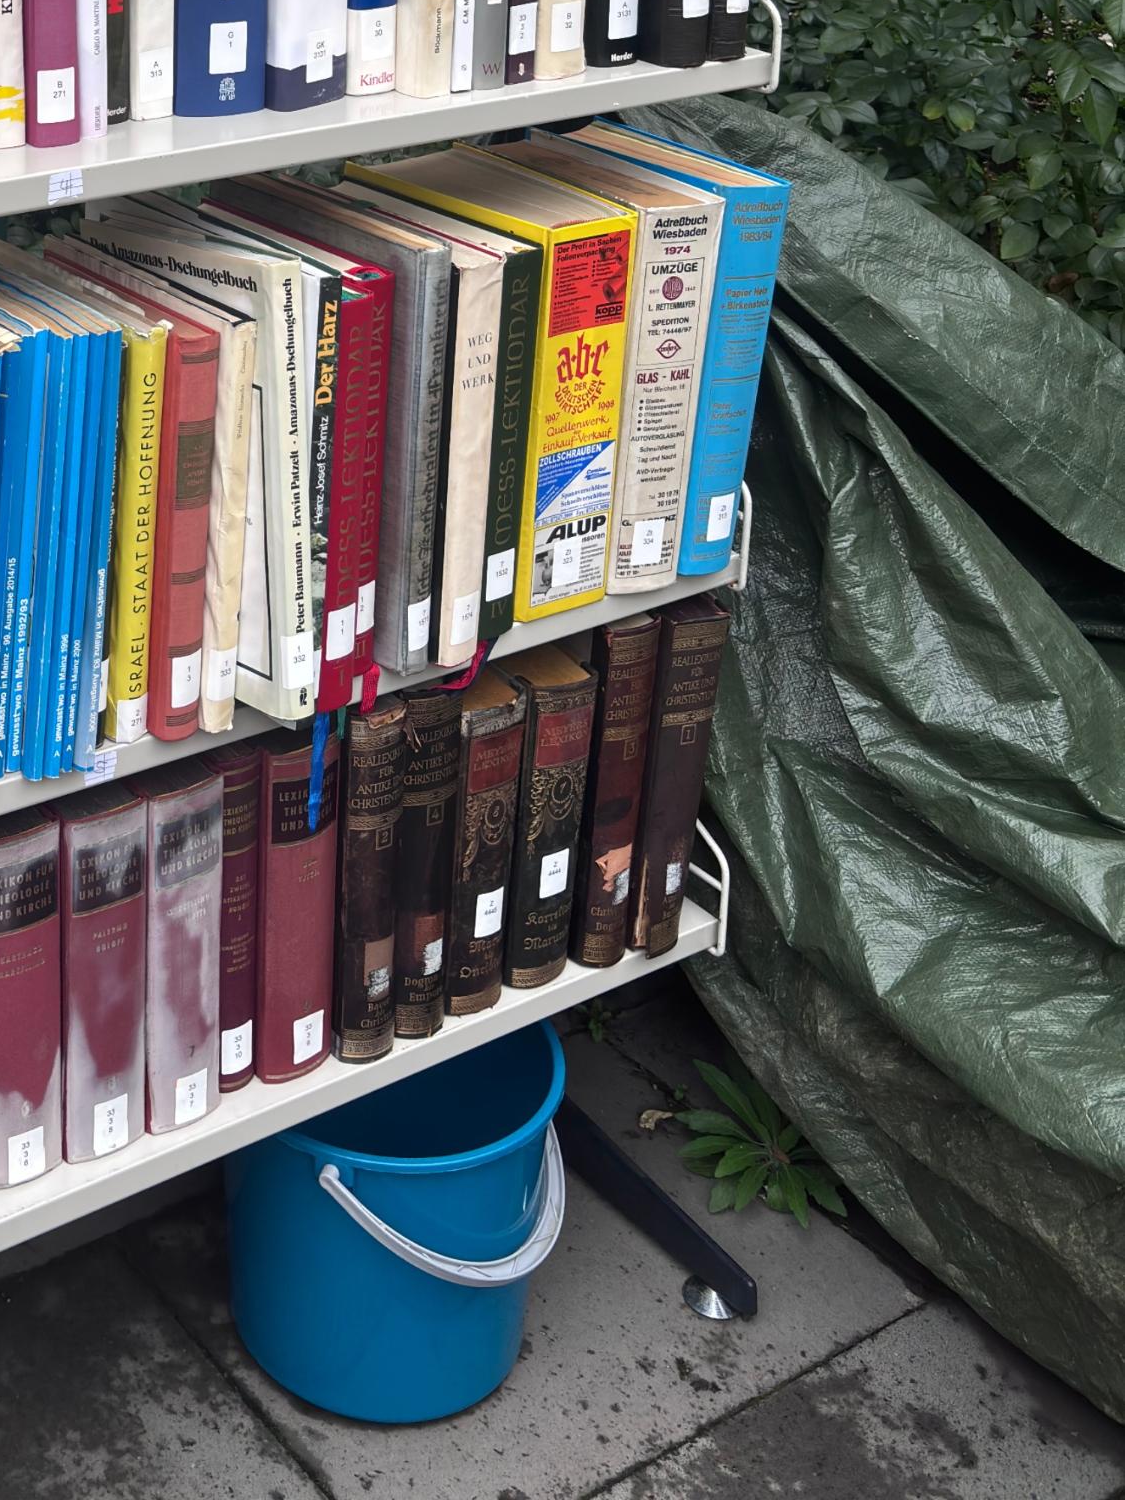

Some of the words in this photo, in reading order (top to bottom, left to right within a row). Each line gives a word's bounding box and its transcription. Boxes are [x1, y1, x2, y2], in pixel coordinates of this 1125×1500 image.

[360, 72, 395, 86] Kindler
[652, 228, 707, 239] Wiesbaden
[655, 214, 708, 228] Adreßbuch
[665, 246, 690, 255] 1974
[652, 262, 698, 275] UMZÜGE
[596, 305, 622, 316] kopp
[652, 317, 689, 326] SPEDITION
[317, 300, 338, 357] Harz
[282, 277, 299, 436] Amazonas-Dschungelbuch
[315, 364, 335, 404] Der
[637, 372, 658, 384] GLAS
[671, 369, 690, 381] KAHL
[137, 372, 157, 496] HOFFNUNG
[317, 416, 330, 460] Schmitz
[543, 428, 612, 453] Einkauf-Verkauf
[547, 416, 609, 437] Quellenwerk
[290, 450, 301, 492] Patzelt
[540, 443, 602, 467] ZOLLSCHRAUBEN
[313, 463, 326, 524] Heinz-Josef
[136, 503, 151, 543] DER
[291, 495, 302, 527] Erwin
[546, 514, 606, 544] ALUP
[132, 547, 148, 614] STAAT
[292, 542, 304, 598] Baumann
[293, 600, 306, 633] Peter
[128, 633, 145, 700] ISRAEL
